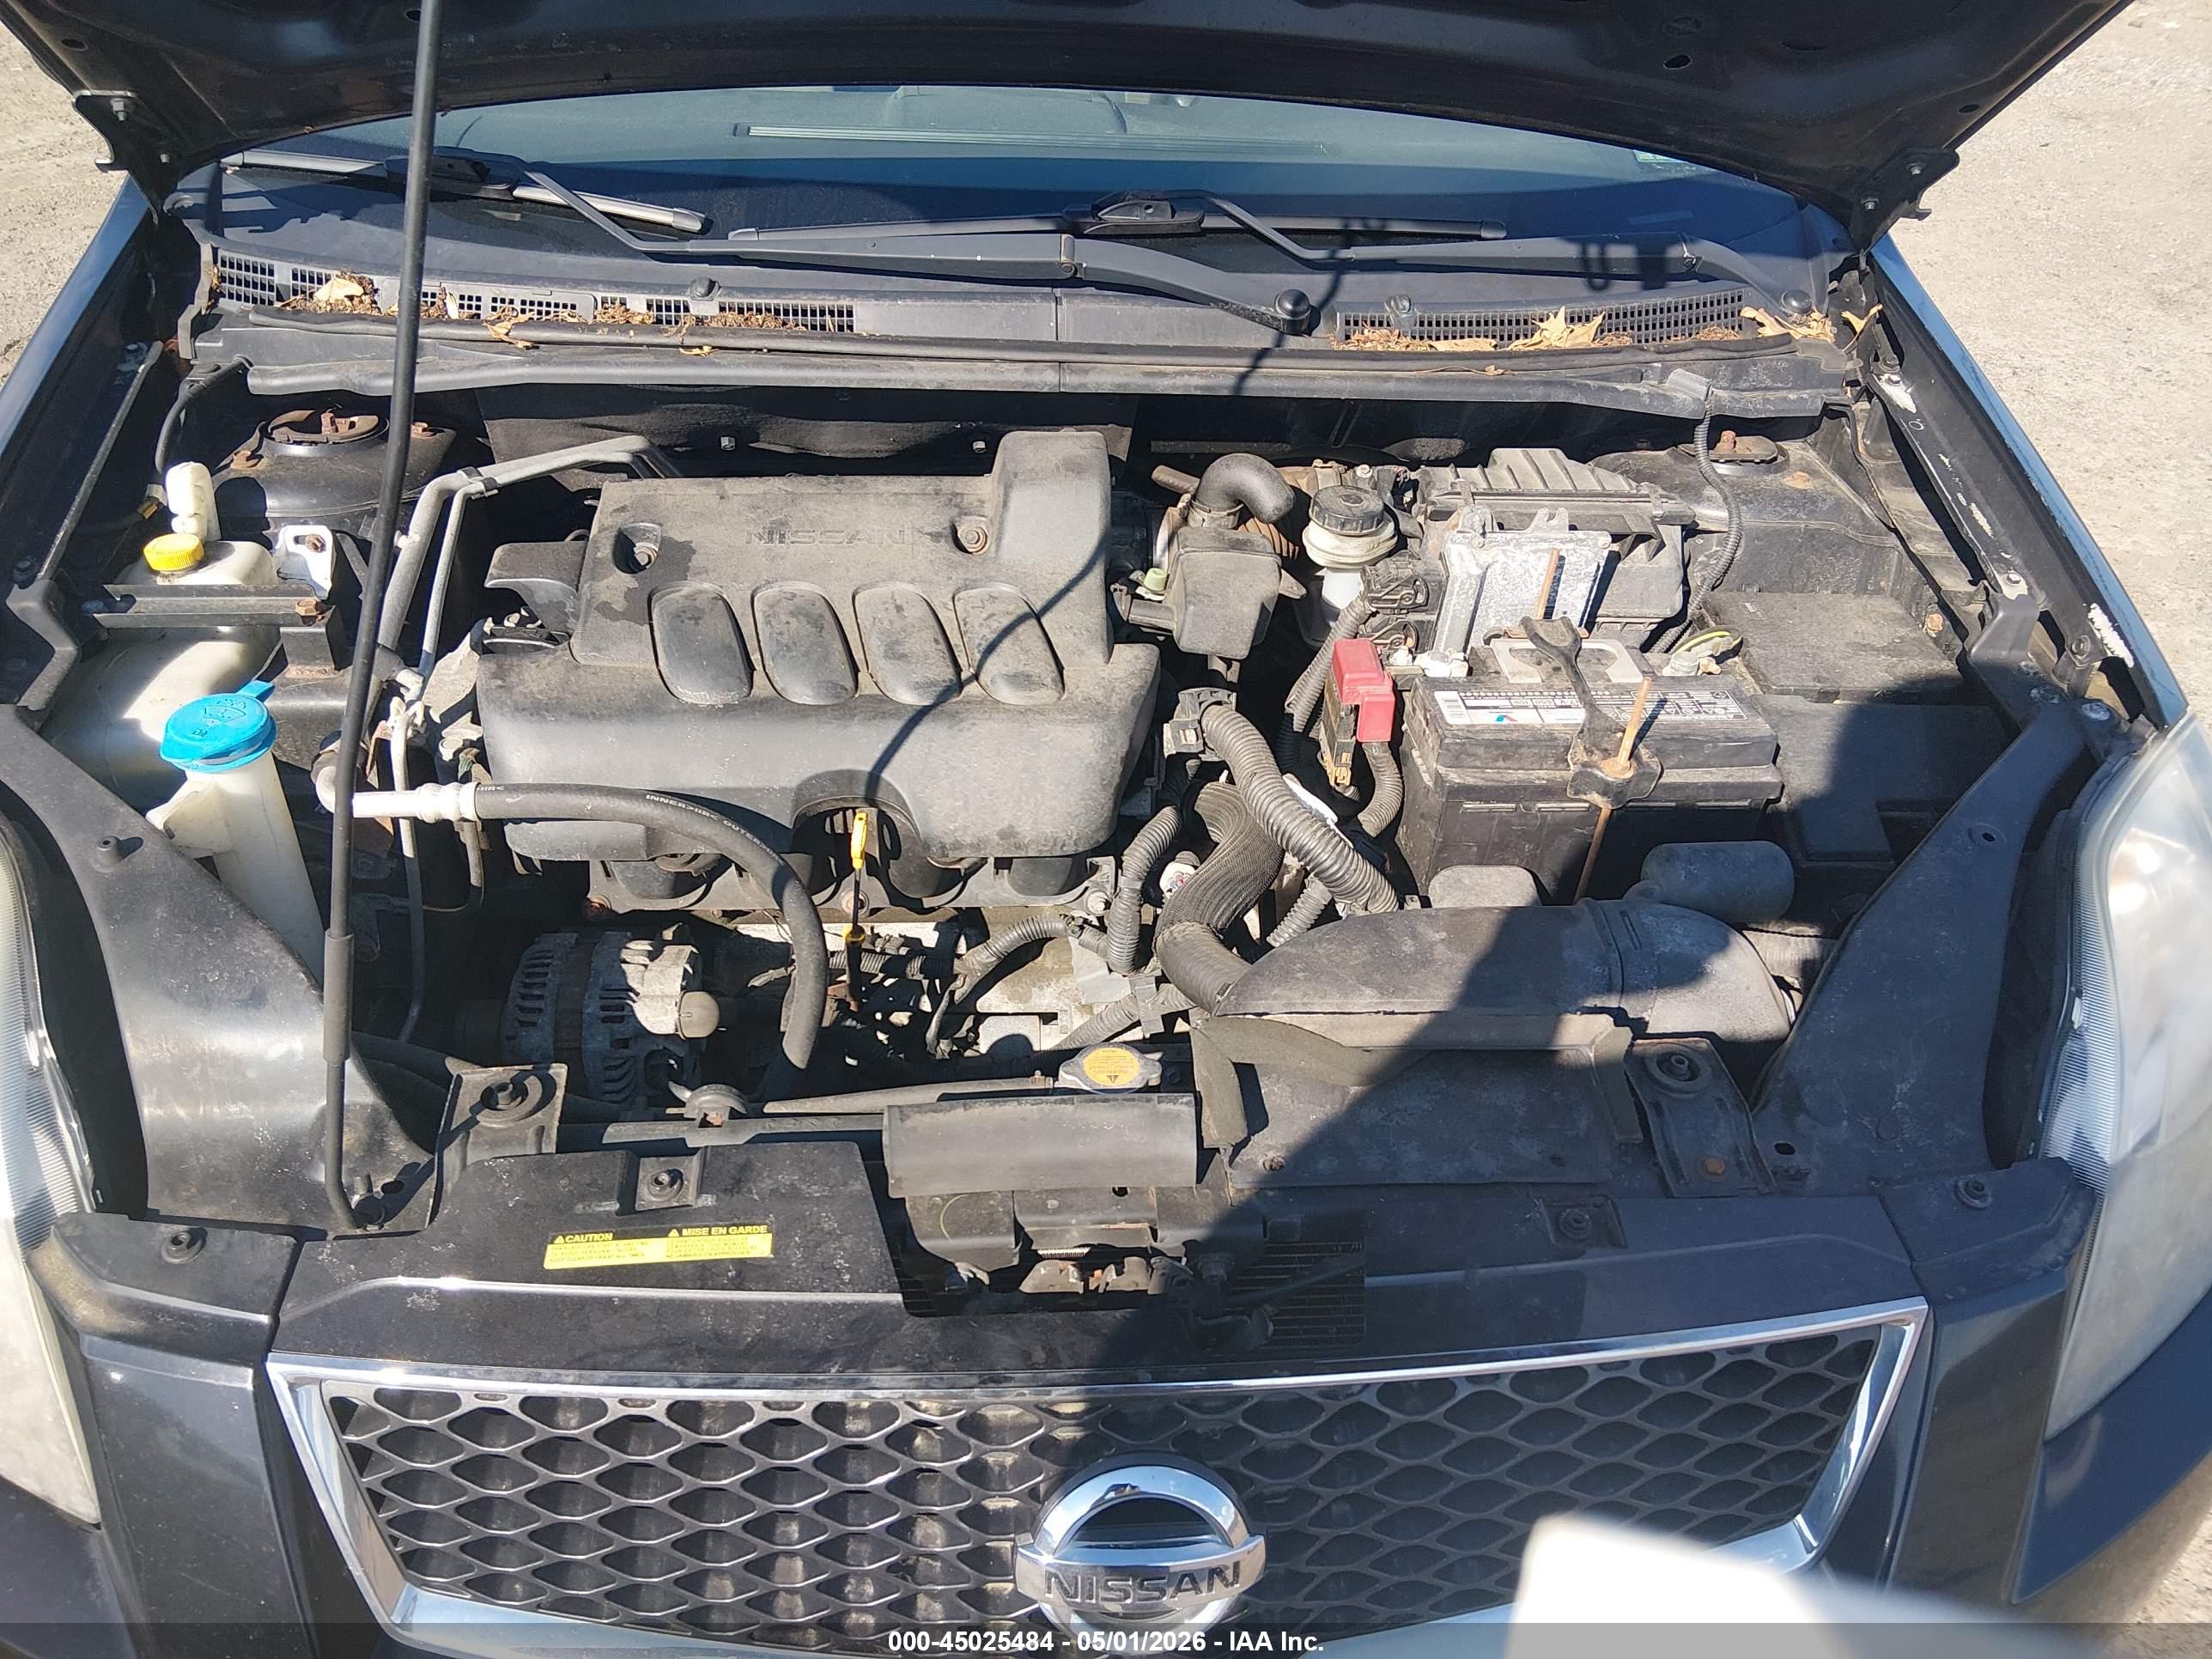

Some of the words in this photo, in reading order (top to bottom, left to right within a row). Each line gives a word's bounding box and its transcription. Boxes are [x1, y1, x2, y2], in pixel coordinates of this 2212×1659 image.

[745, 529, 905, 545] NISSAN
[565, 1232, 613, 1243] CAUTION
[682, 1227, 710, 1237] MISE
[711, 1226, 727, 1236] EN
[728, 1224, 769, 1235] GARDE
[1045, 1561, 1241, 1604] NISSAN
